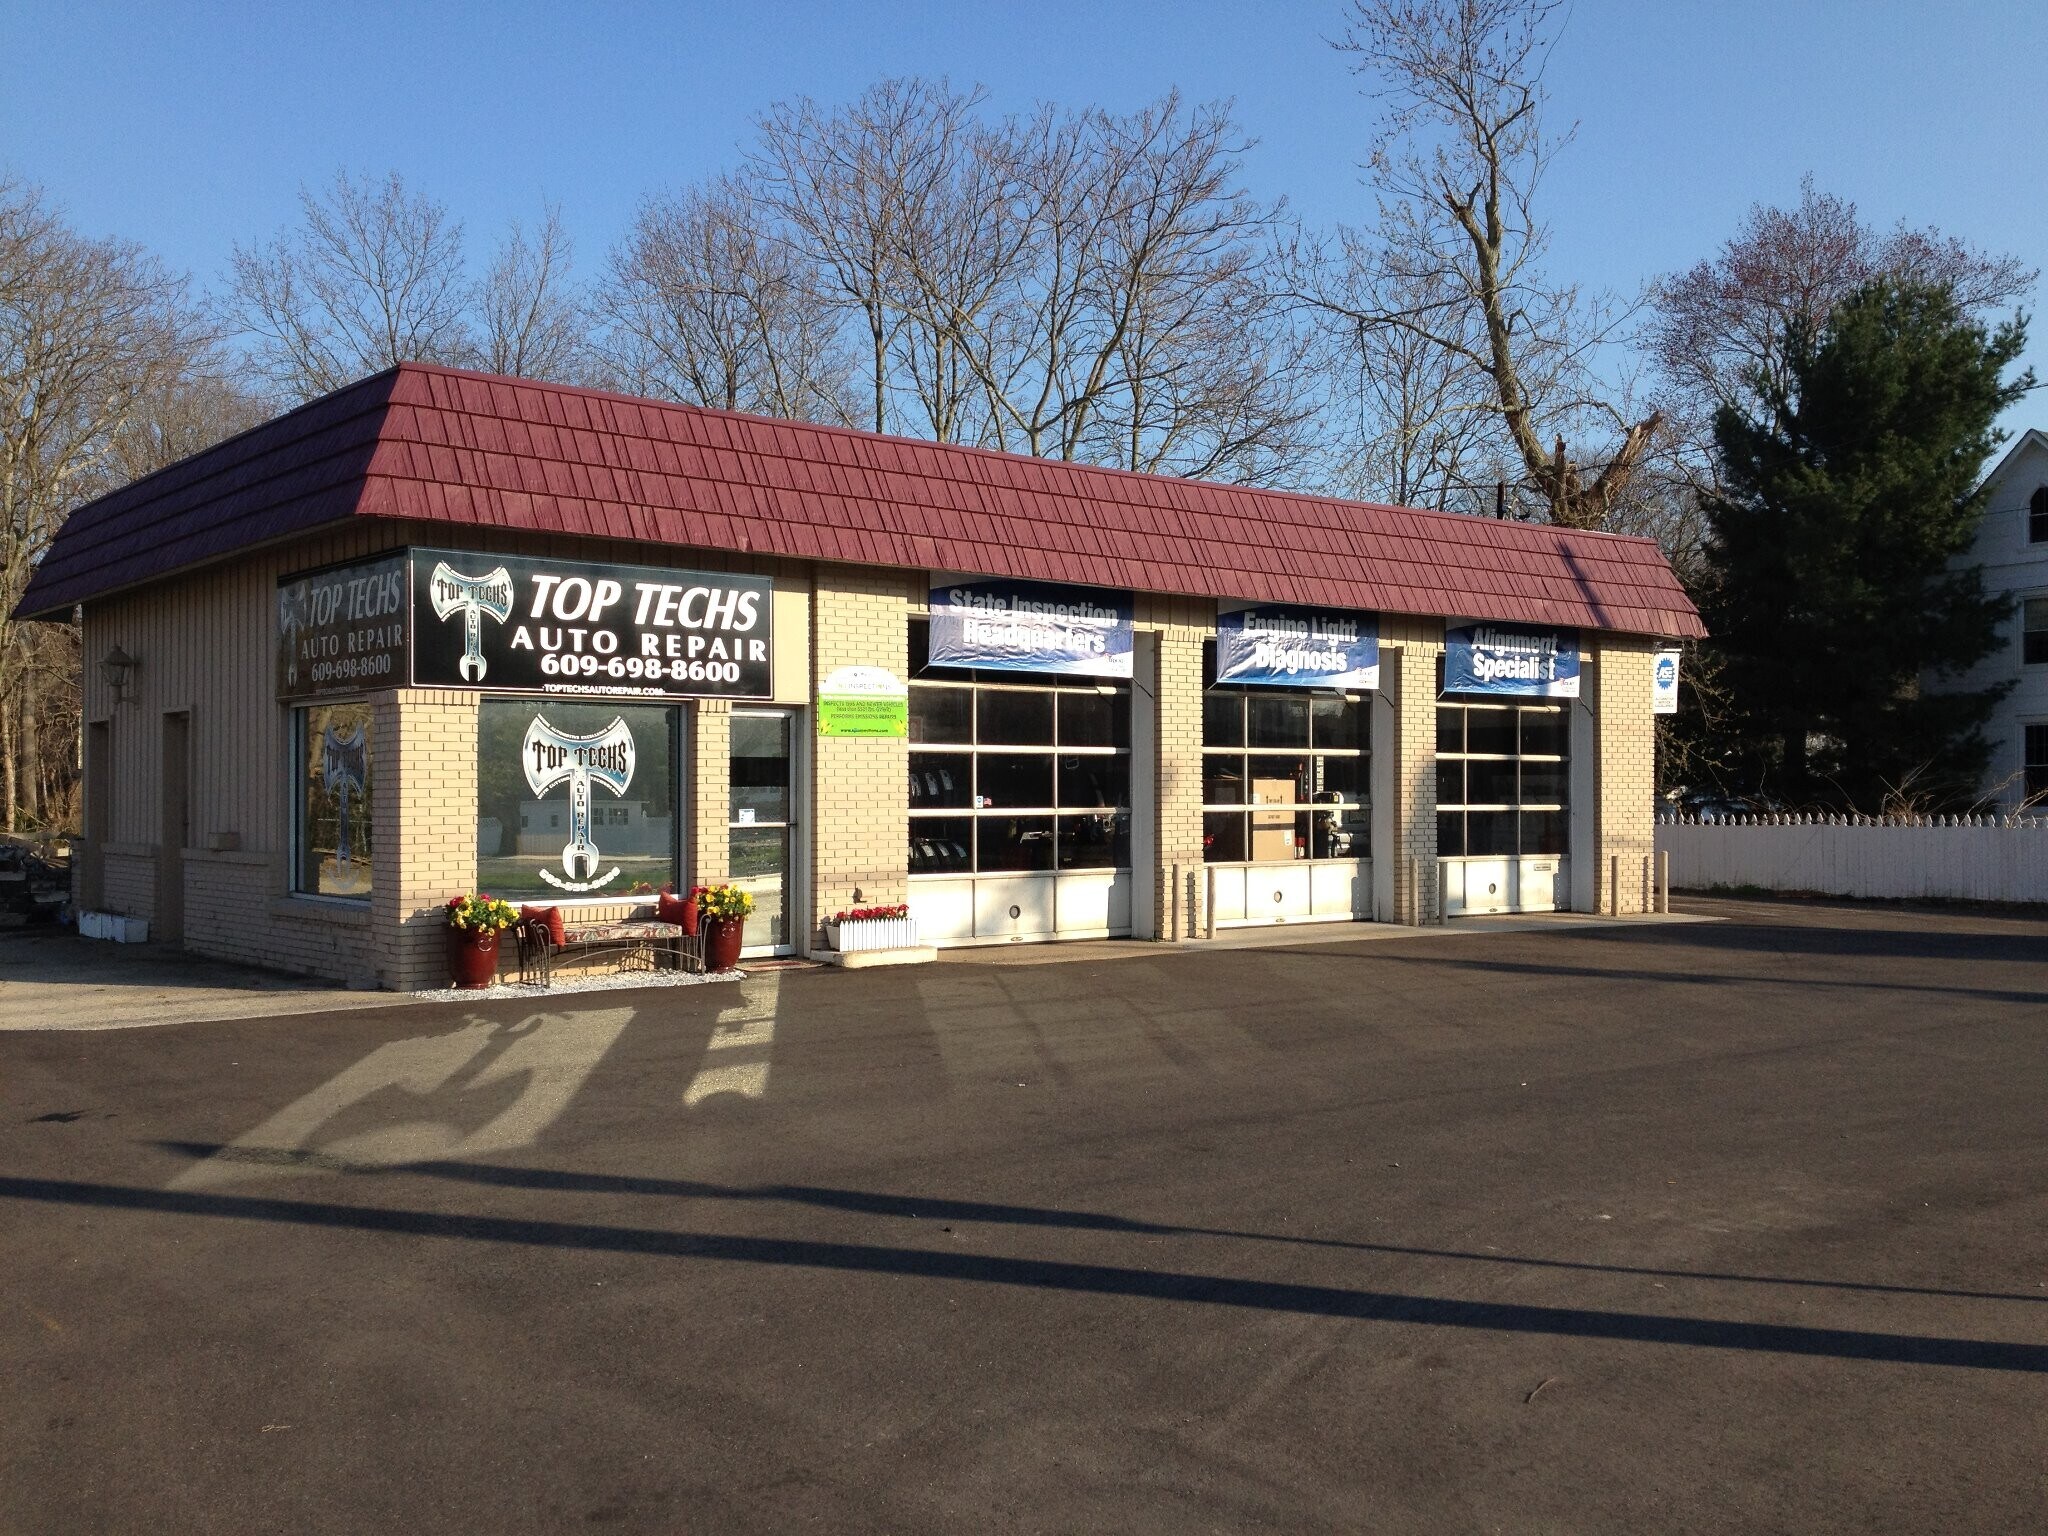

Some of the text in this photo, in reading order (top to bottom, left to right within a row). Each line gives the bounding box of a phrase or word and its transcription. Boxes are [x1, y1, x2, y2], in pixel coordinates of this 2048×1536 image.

[310, 583, 343, 628] TOP
[348, 569, 401, 621] TECHS
[437, 578, 463, 602] TOP
[530, 574, 761, 631] TOP TECHS
[949, 588, 1118, 627] State Inspection
[302, 624, 403, 660] AUTO REPAIR
[510, 626, 767, 662] AUTO REPAIR
[963, 618, 1106, 653] Headquarters
[1242, 611, 1358, 646] Engine Light
[1471, 627, 1559, 657] Alignment
[311, 654, 391, 682] 609-698-8600
[540, 654, 740, 683] 609-698-8600
[1255, 640, 1347, 675] Diagnosis
[1472, 652, 1556, 682] Specialist
[532, 739, 568, 774] TOP
[576, 780, 585, 807] AUTO
[576, 812, 585, 851] REPAIR
